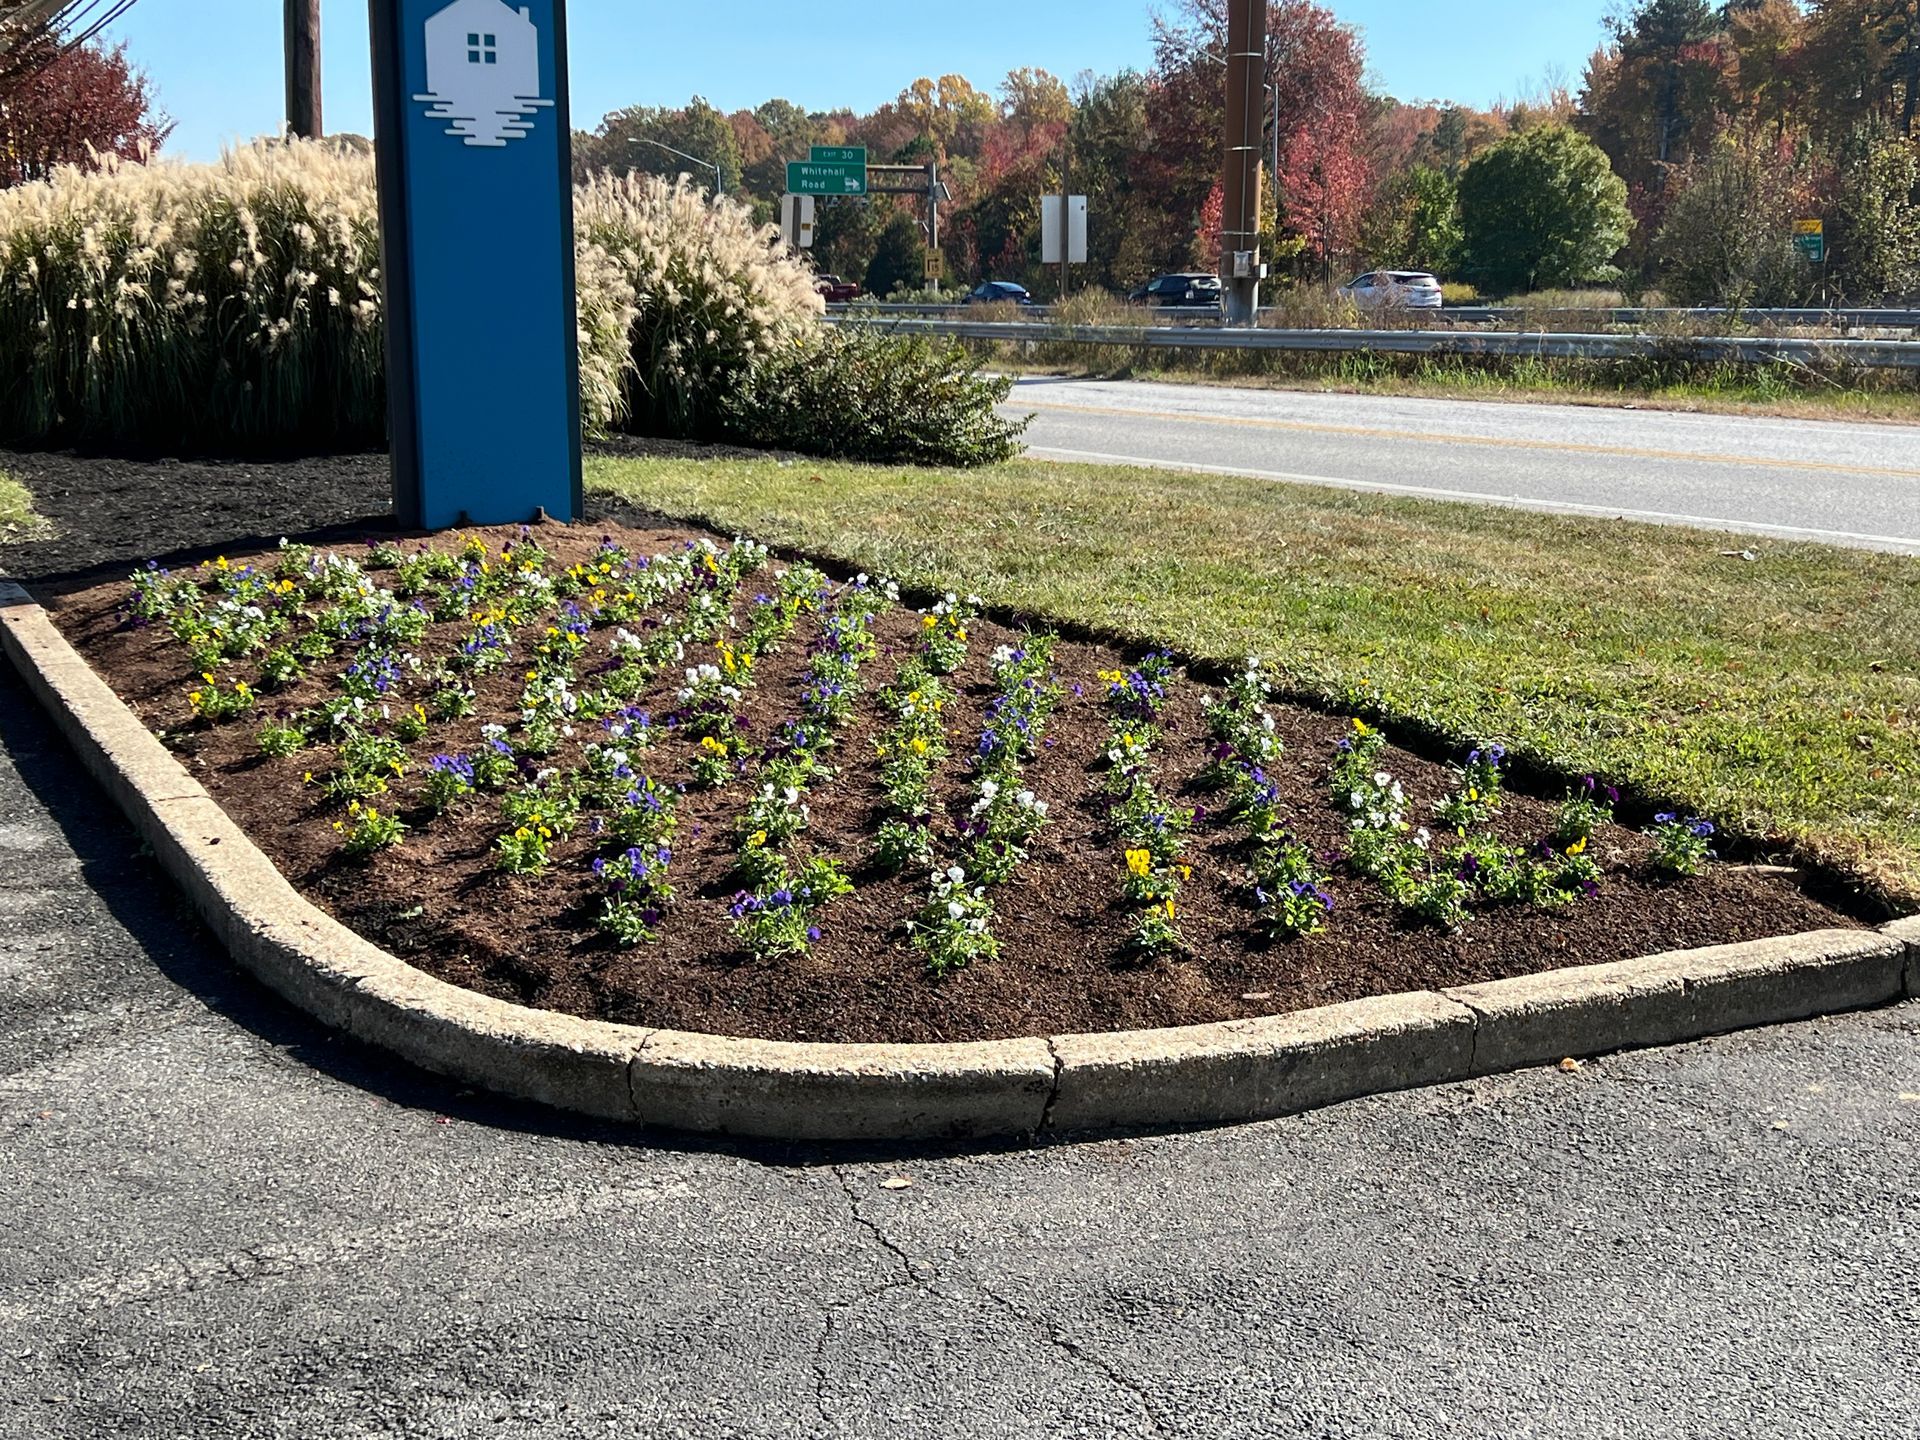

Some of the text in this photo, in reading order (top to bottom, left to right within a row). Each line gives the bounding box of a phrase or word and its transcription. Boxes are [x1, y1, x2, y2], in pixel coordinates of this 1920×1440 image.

[841, 150, 854, 160] 30
[801, 167, 845, 176] Whitehall
[801, 179, 826, 189] Road
